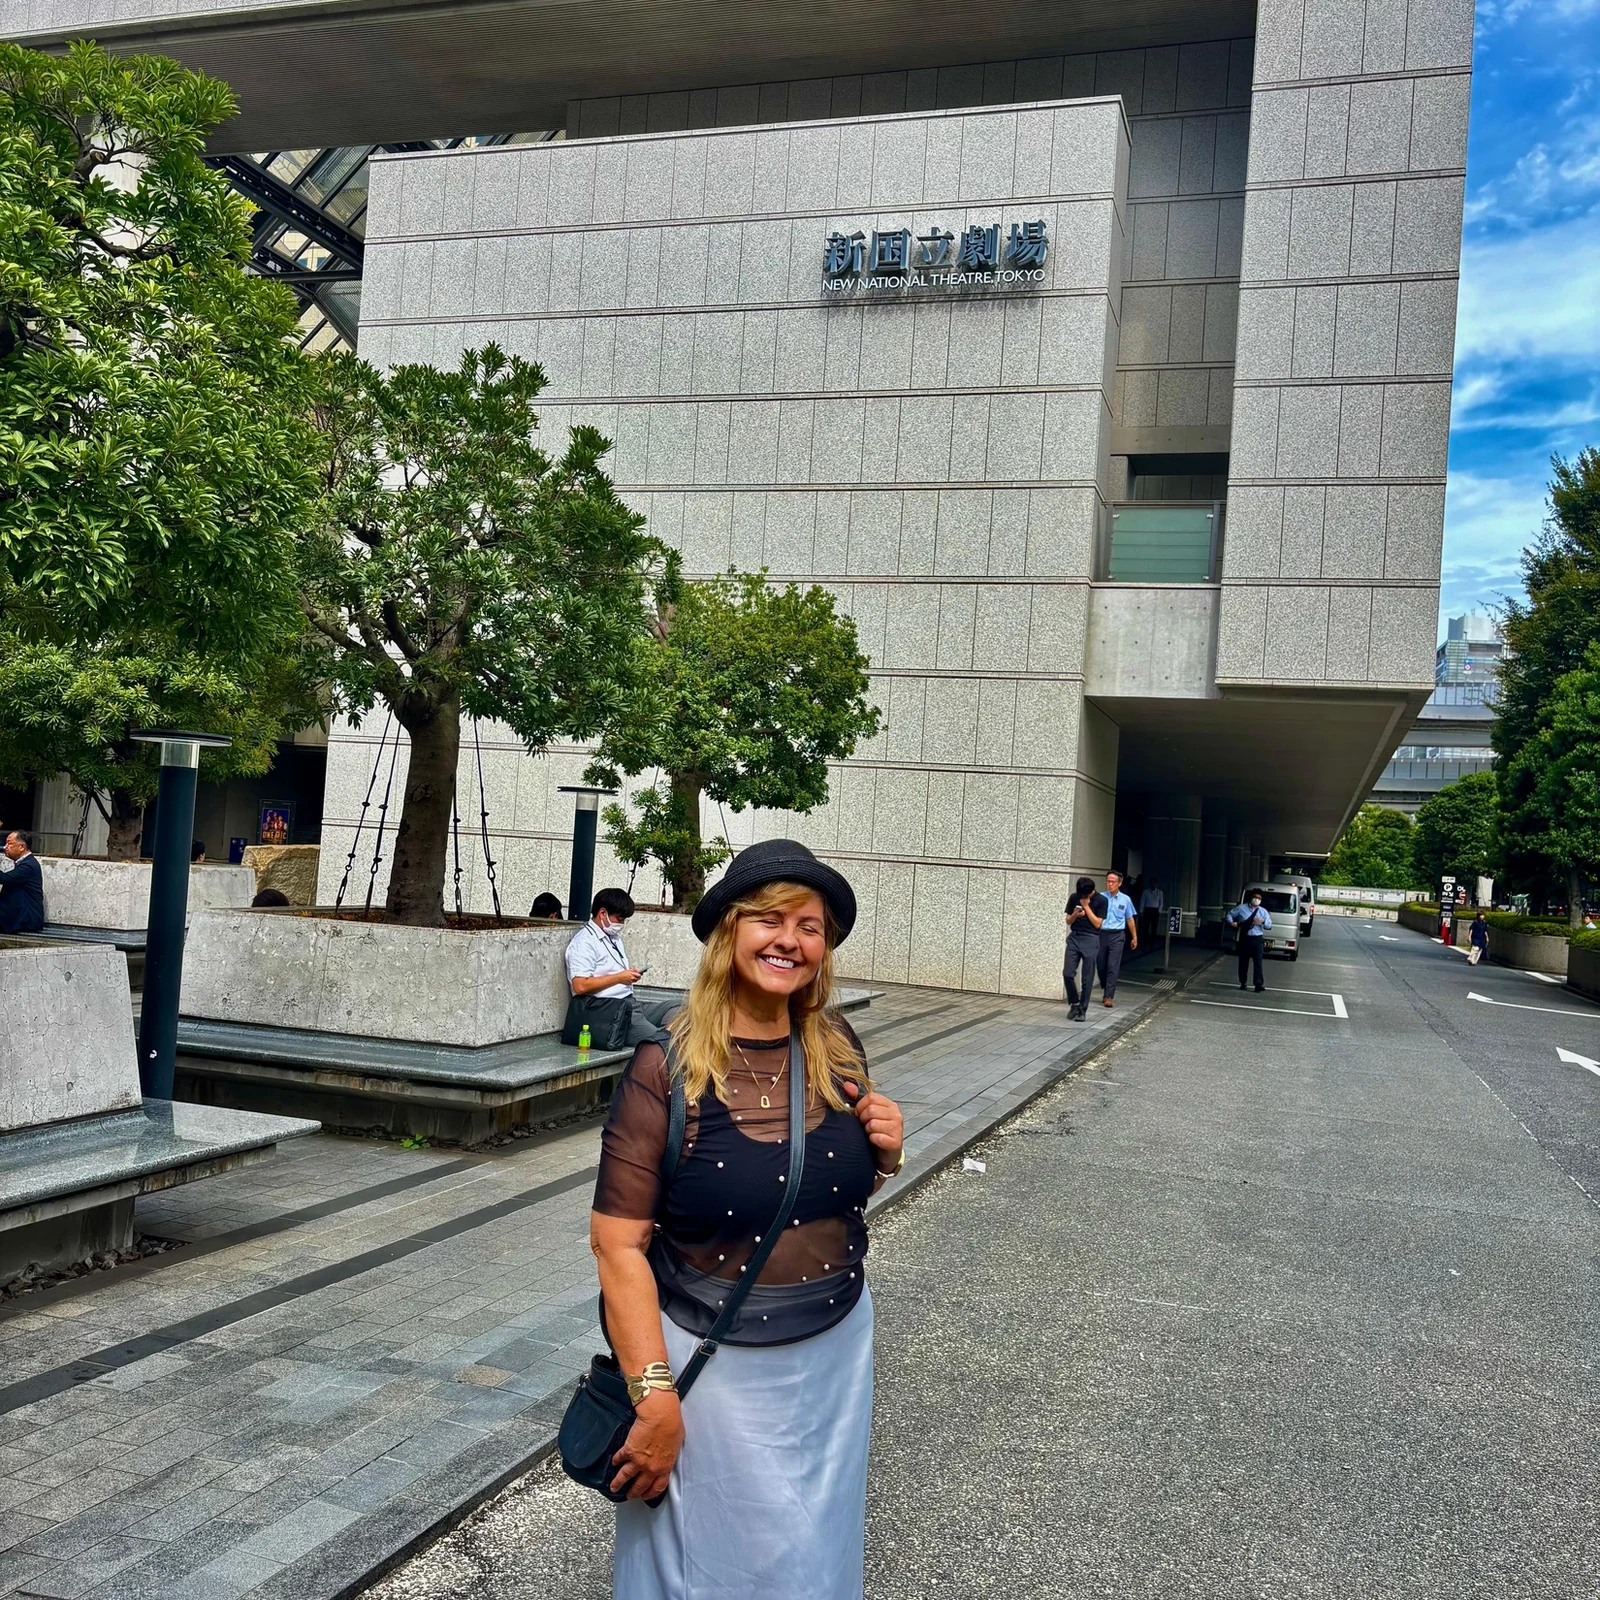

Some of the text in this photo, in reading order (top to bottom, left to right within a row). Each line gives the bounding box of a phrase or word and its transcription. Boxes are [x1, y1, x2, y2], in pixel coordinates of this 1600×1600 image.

[824, 219, 1049, 275] 新国立劇場
[822, 278, 856, 291] NEW
[858, 275, 928, 289] NATIONAL
[995, 269, 1046, 282] TOKYO
